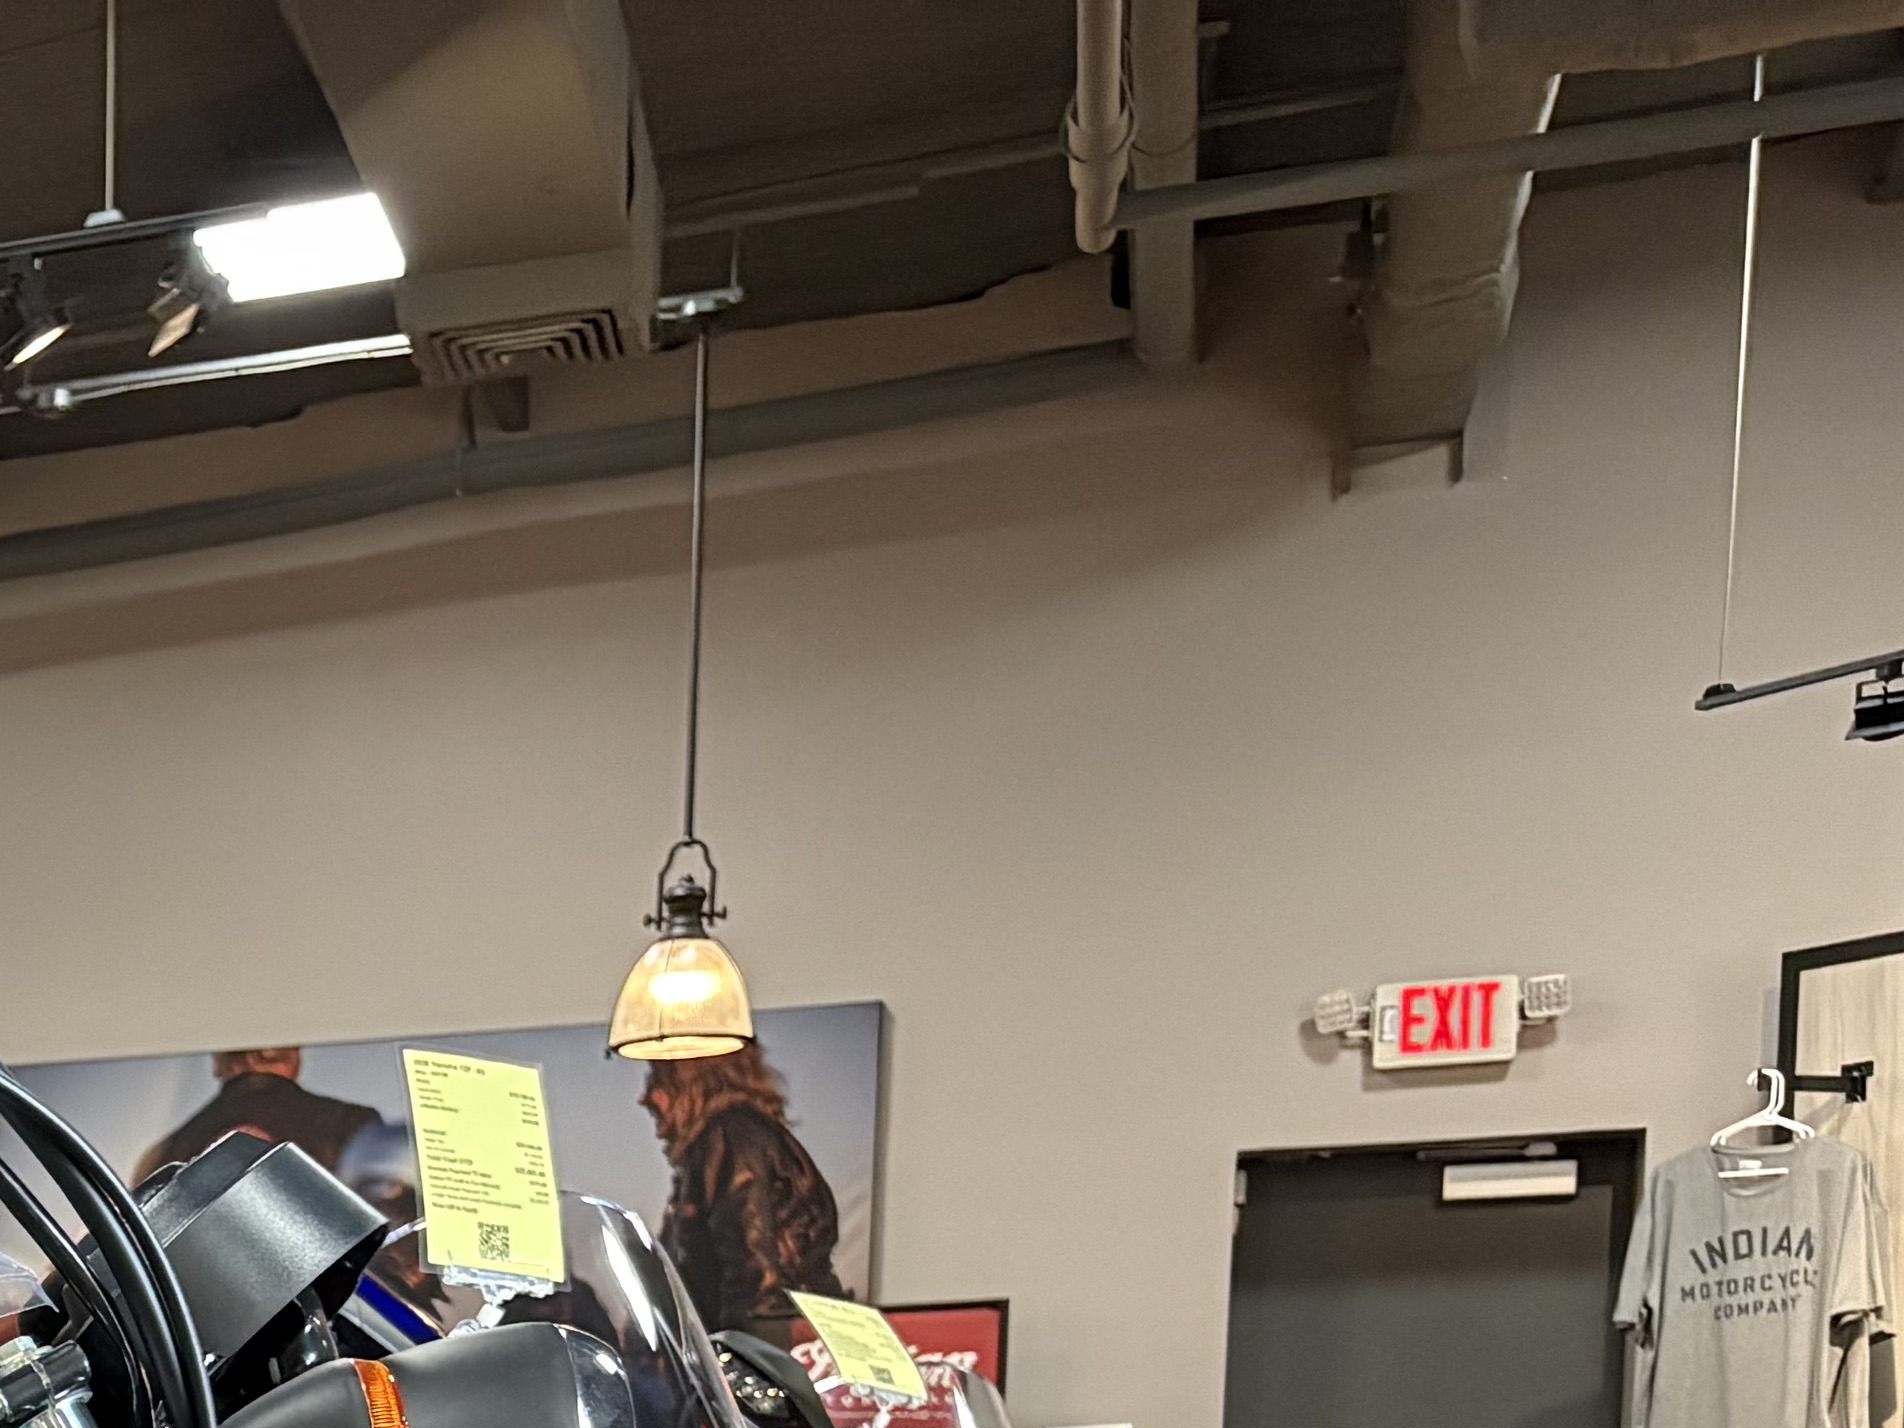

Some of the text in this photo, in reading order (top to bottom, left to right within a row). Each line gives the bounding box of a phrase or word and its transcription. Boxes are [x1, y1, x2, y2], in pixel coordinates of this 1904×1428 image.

[1398, 981, 1499, 1055] EXIT
[1689, 1225, 1815, 1275] INDIAN
[1680, 1267, 1819, 1303] MOTORCYCL
